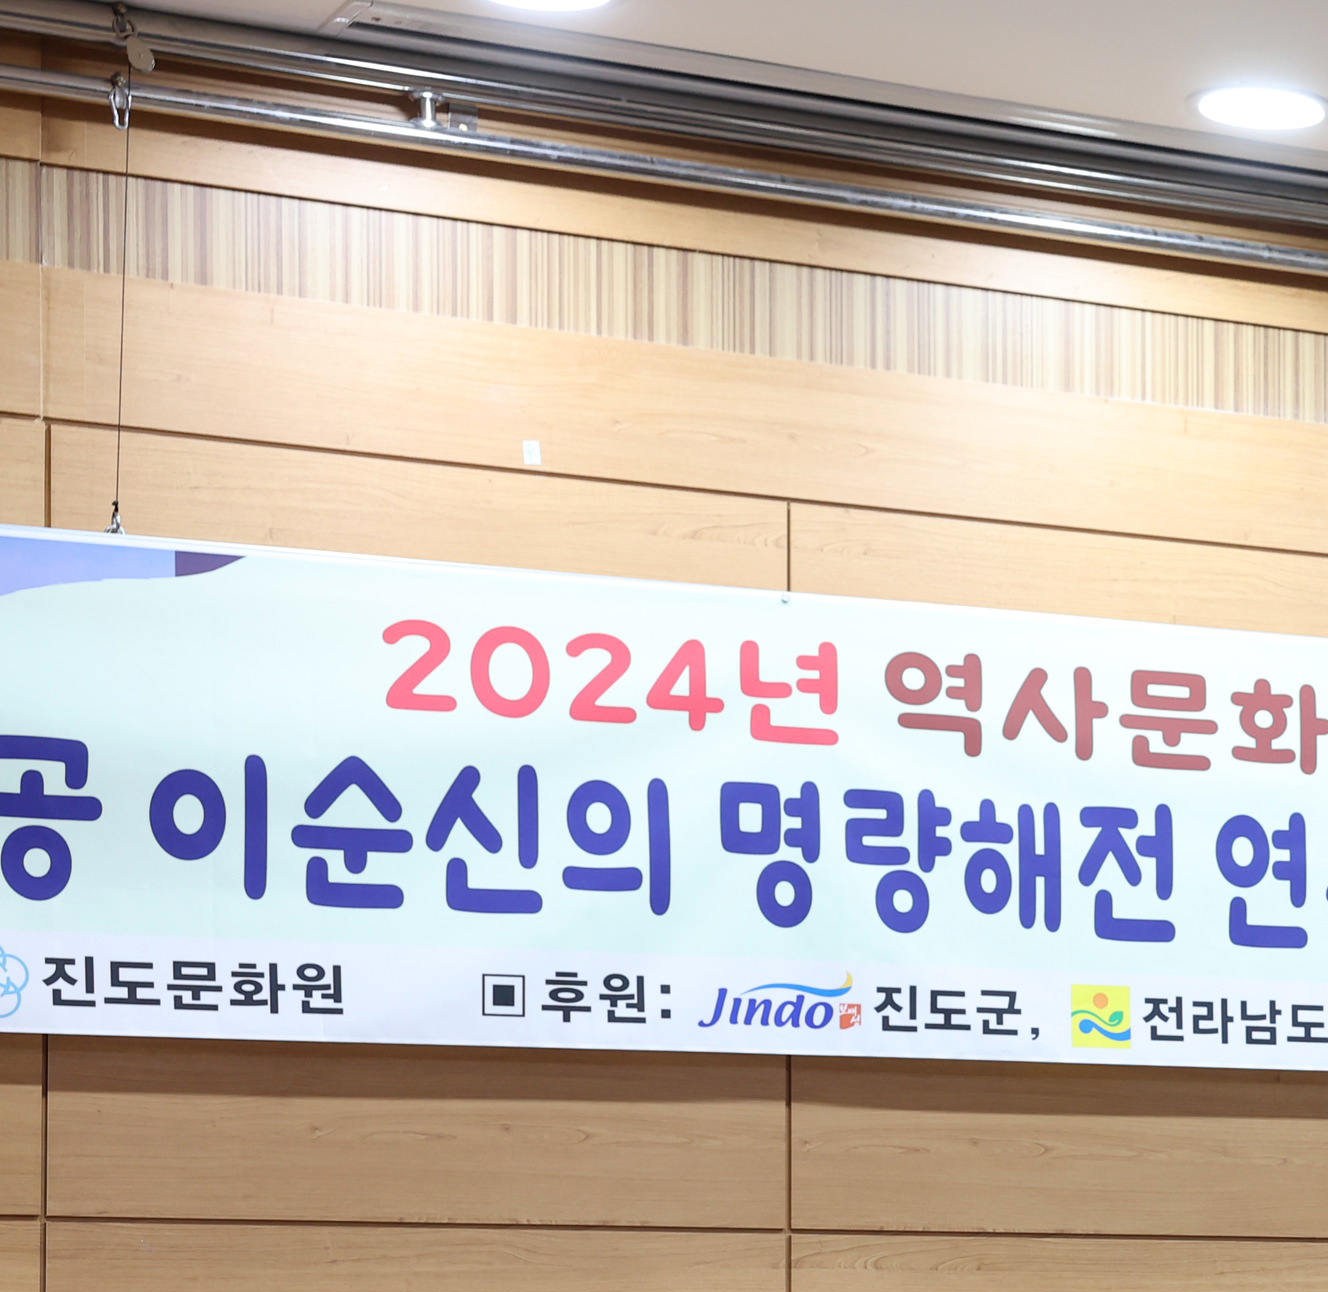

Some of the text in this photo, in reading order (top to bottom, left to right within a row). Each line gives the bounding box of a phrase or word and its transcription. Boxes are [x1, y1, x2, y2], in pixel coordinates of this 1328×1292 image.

[382, 619, 839, 746] 2024년
[0, 734, 103, 902] 공
[148, 754, 672, 916] 이순신의
[719, 780, 1176, 943] 명량해전
[41, 955, 344, 1016] 진도문화원
[541, 971, 672, 1024] 후원:
[697, 987, 834, 1030] Jindo
[873, 984, 1040, 1041] 진도군,
